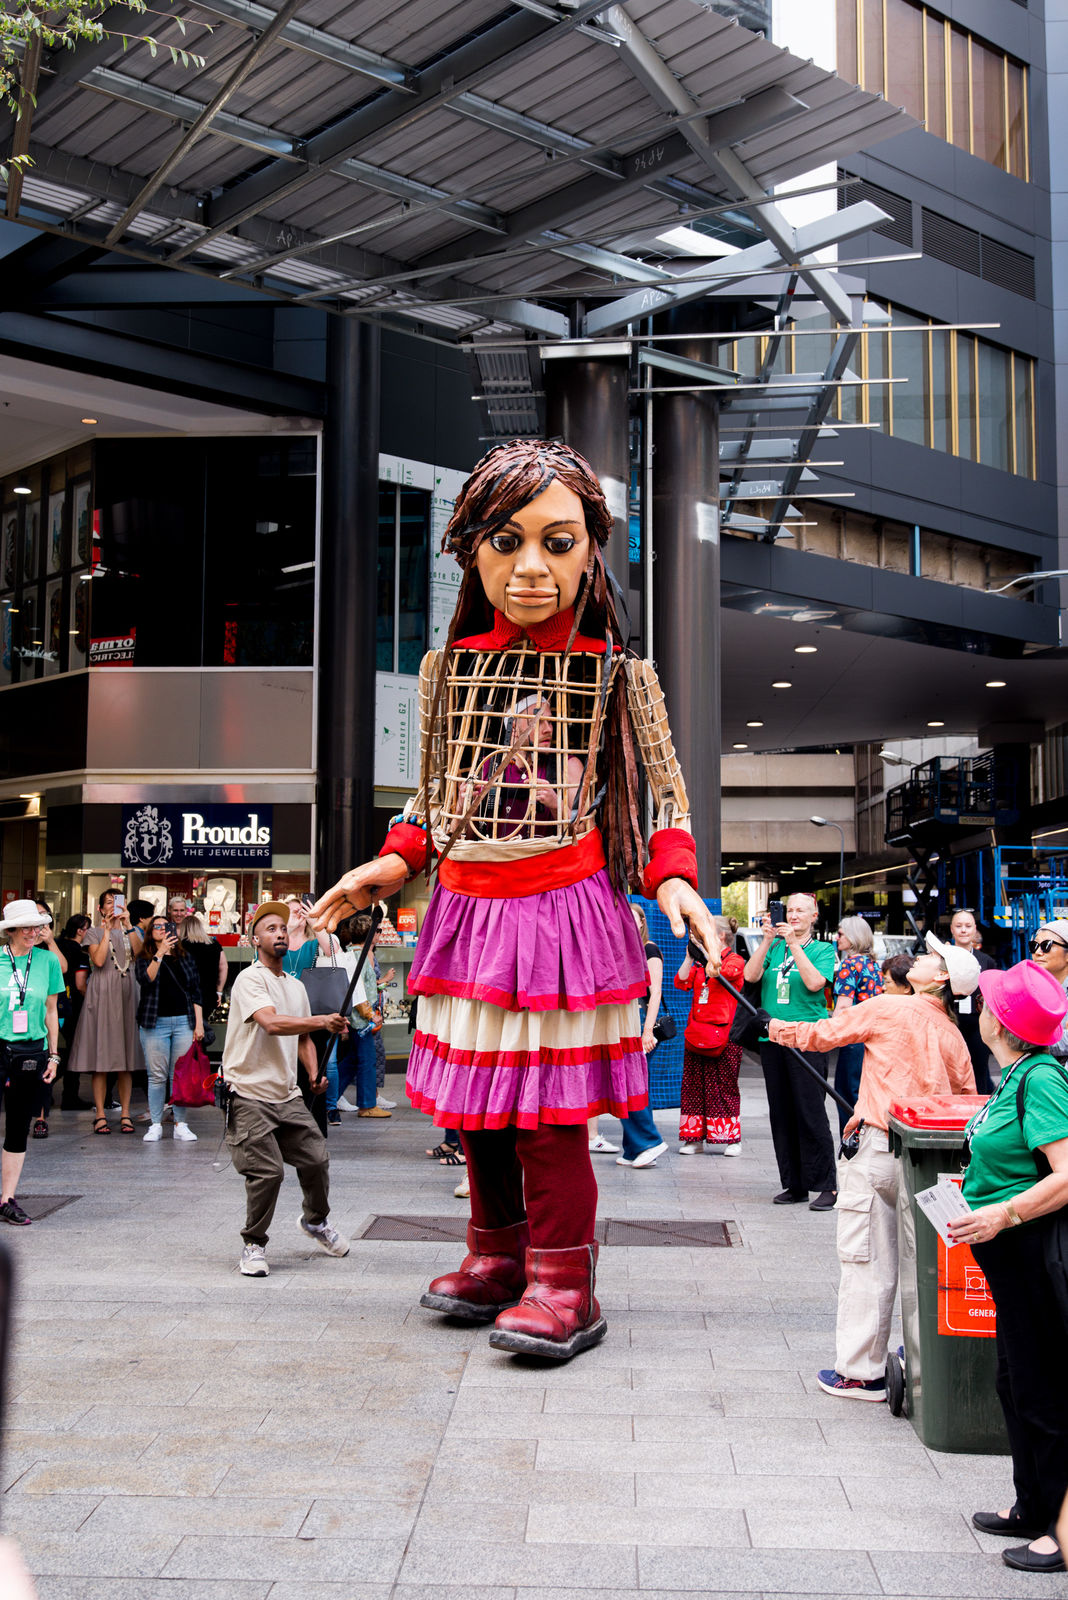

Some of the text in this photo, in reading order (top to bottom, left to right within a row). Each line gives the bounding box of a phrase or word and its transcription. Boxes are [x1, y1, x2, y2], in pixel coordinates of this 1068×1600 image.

[398, 702, 407, 715] G2
[182, 813, 271, 845] Prouds
[183, 849, 270, 857] THE JEWELLERS
